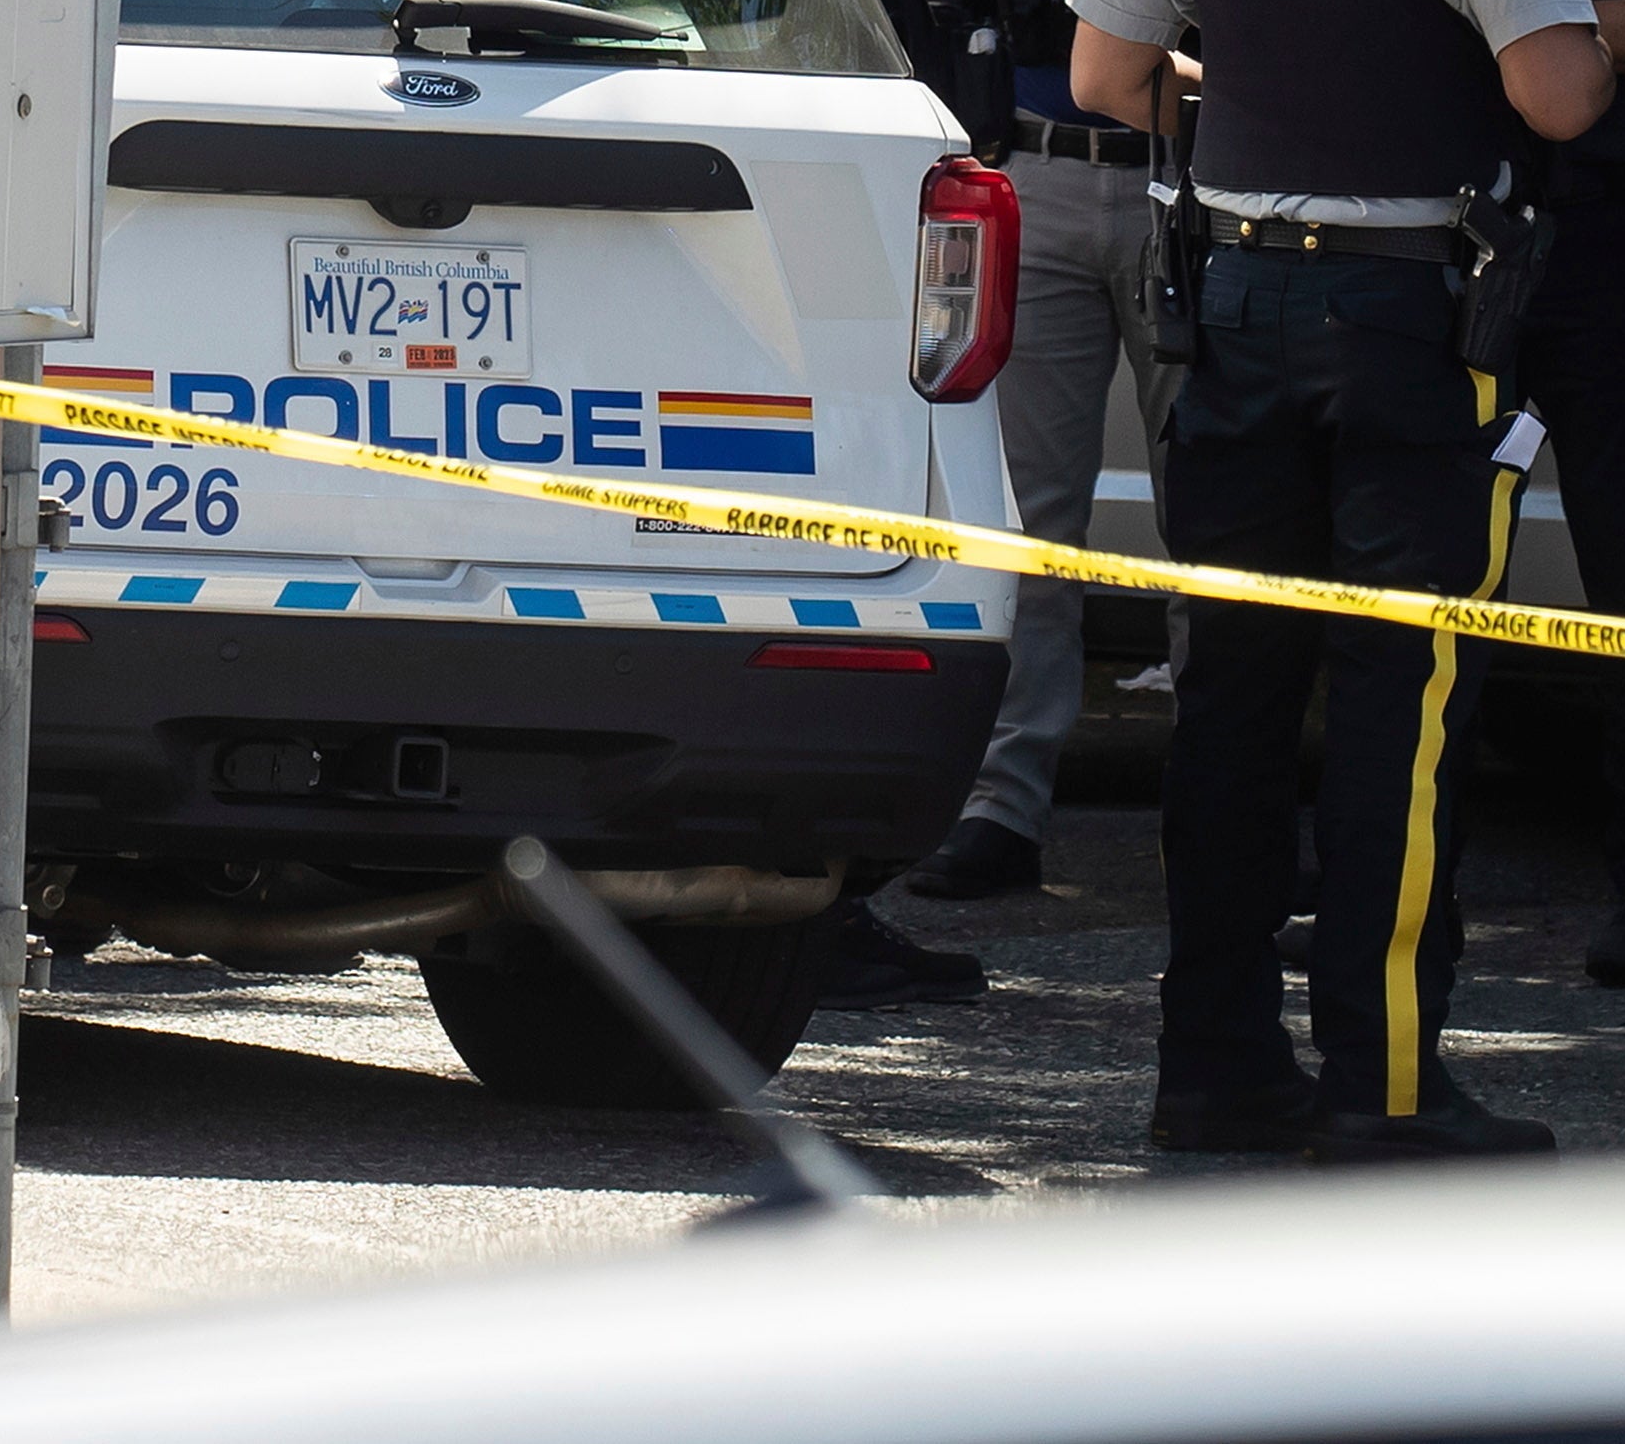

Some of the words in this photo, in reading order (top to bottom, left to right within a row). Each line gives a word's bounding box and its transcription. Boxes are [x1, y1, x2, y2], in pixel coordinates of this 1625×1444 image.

[405, 72, 460, 99] Ford
[314, 257, 381, 276] Beautiful
[385, 260, 432, 279] British
[436, 262, 510, 281] Columbia
[304, 273, 398, 337] MV2
[438, 279, 522, 342] 19T
[378, 347, 392, 358] 28
[169, 372, 647, 469] POLICE
[1431, 600, 1539, 640] PASSAGE
